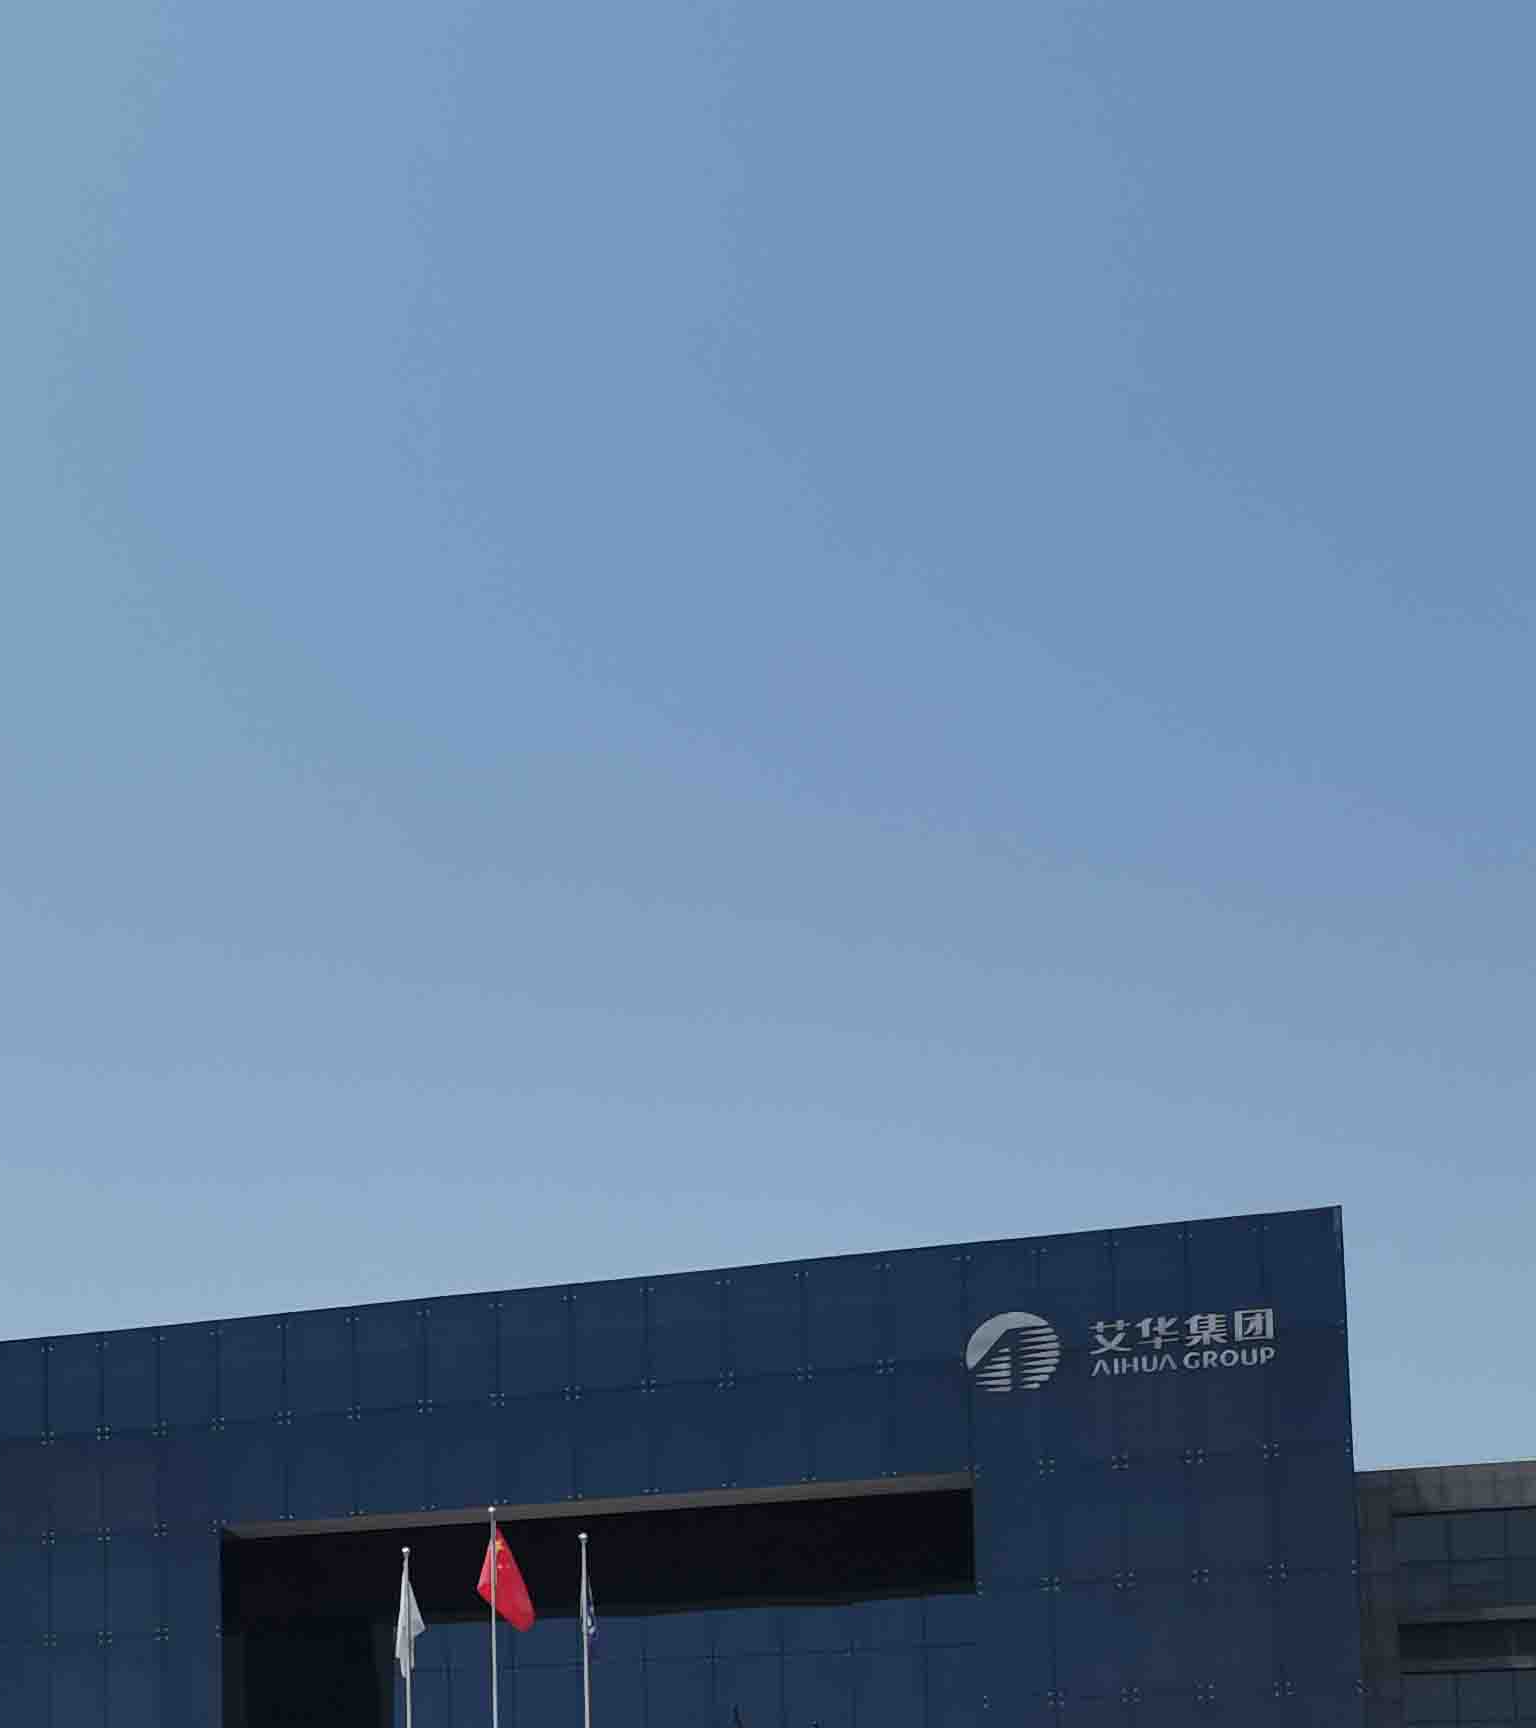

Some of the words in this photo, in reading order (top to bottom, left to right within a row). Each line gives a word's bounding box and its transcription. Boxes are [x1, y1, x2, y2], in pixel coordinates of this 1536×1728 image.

[1088, 1307, 1275, 1355] 艾华集团
[1091, 1356, 1178, 1377] AIHUA
[1183, 1346, 1276, 1370] GROUP
